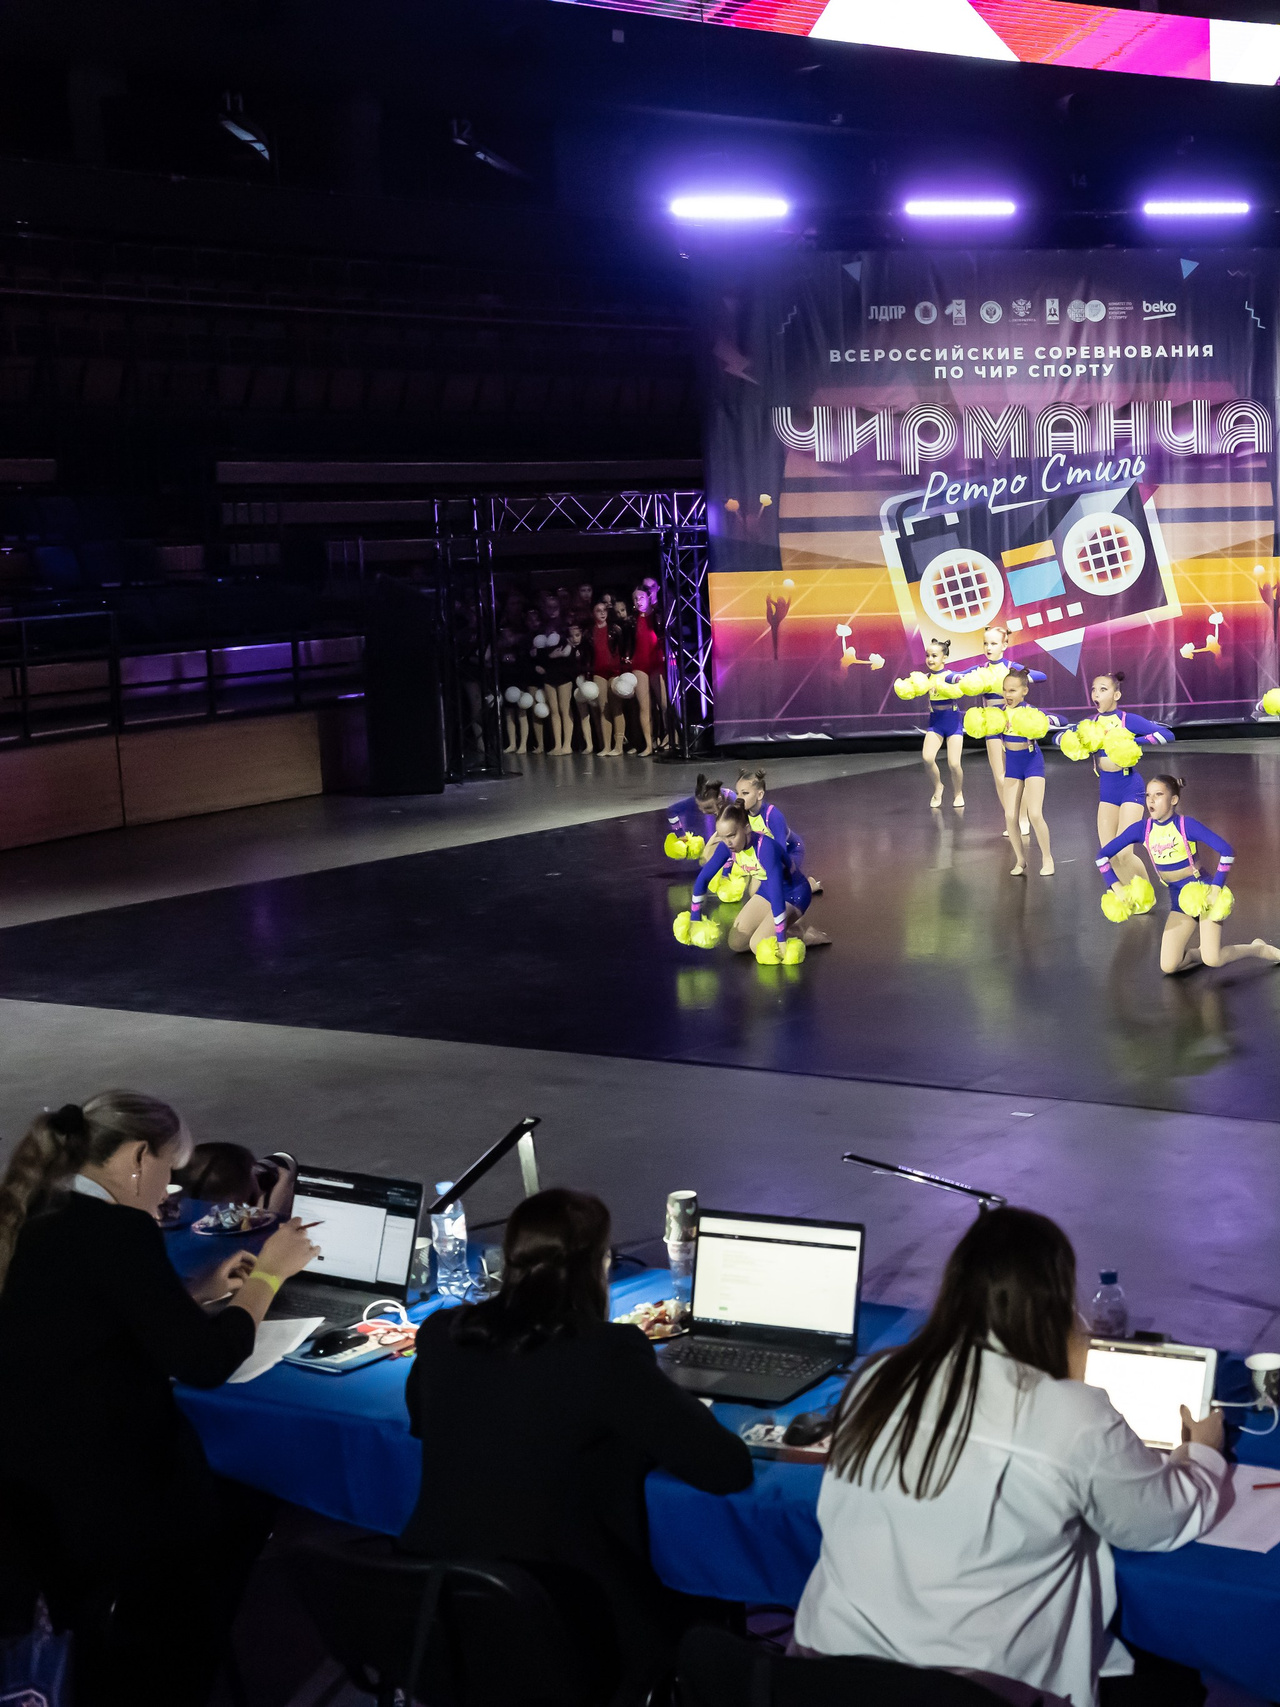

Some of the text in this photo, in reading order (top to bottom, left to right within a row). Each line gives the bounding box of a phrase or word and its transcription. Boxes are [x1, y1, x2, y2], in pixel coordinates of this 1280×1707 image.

[868, 305, 906, 321] ЛДПР
[1142, 300, 1177, 313] beko
[829, 344, 1215, 363] ВСЕРОССИЙСКИЕ СОРЕВНОВАНИЯ
[934, 363, 1115, 379] ПО ЧИР СПОРТУ
[921, 453, 1146, 513] Ретро Стиль
